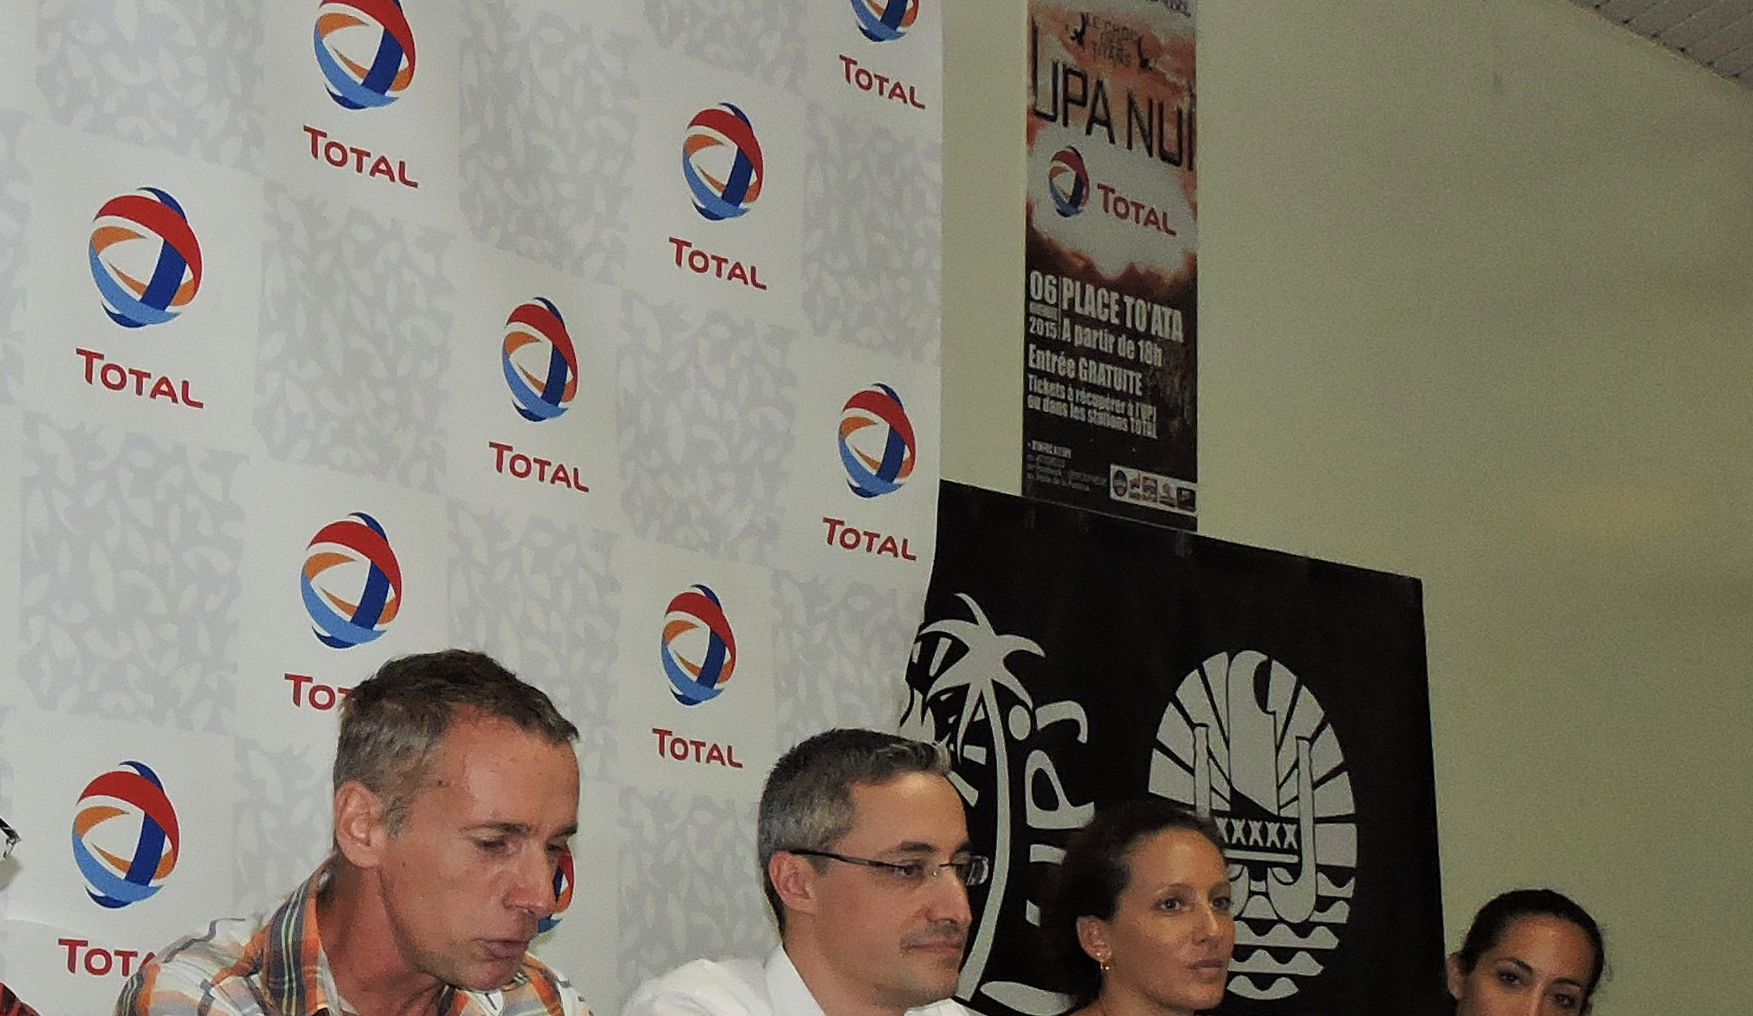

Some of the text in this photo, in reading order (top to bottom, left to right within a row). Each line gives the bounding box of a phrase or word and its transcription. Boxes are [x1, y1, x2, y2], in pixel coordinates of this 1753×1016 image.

[839, 54, 926, 110] TOTAL
[1031, 16, 1115, 145] UPA
[303, 125, 419, 189] TOTAL
[1097, 182, 1177, 237] TOTAL
[669, 236, 767, 290] TOTAL
[1029, 270, 1057, 305] 06
[1062, 276, 1119, 325] PLACE
[1074, 323, 1115, 354] partir
[1117, 333, 1135, 360] de
[75, 347, 204, 409] TOTAL
[1028, 344, 1143, 397] Entrée GRATUITE
[489, 441, 589, 493] TOTAL
[823, 517, 917, 561] TOTAL
[652, 727, 743, 768] TOTAL
[57, 938, 156, 977] TOT
